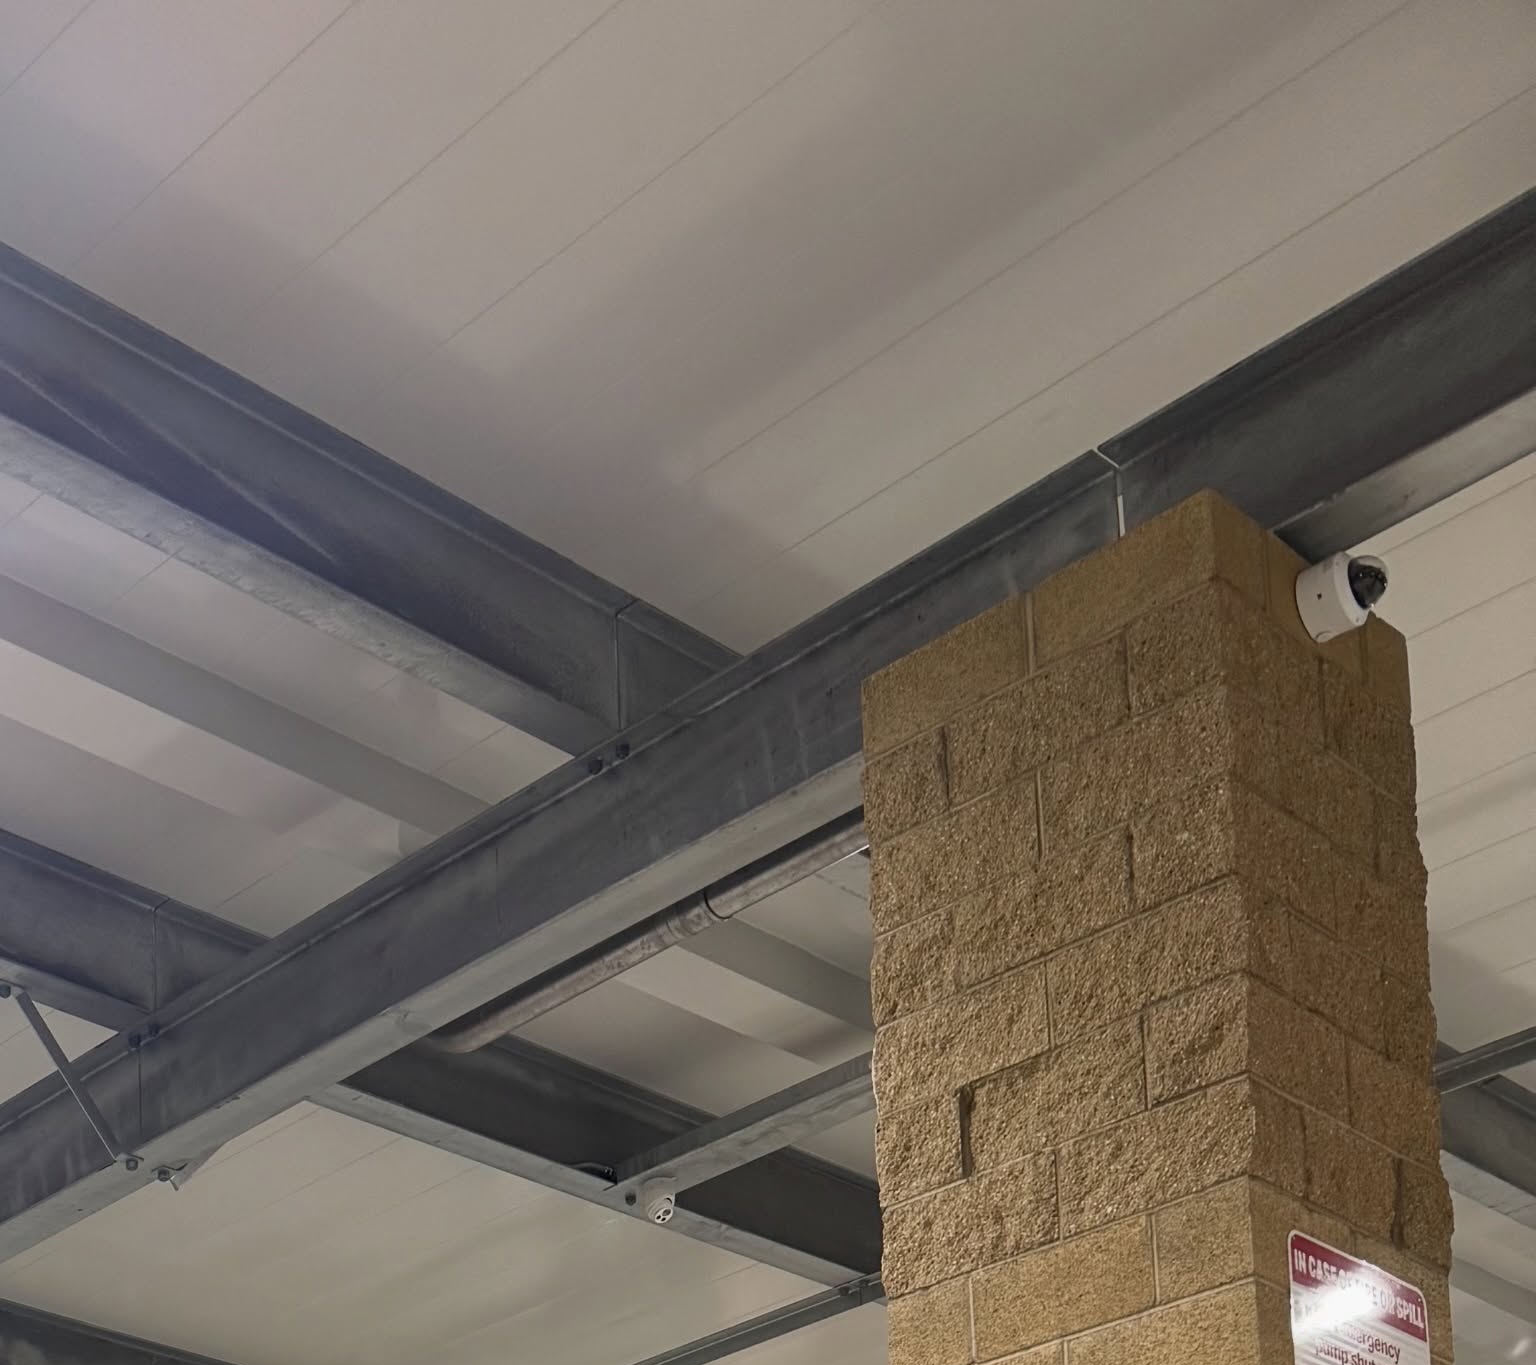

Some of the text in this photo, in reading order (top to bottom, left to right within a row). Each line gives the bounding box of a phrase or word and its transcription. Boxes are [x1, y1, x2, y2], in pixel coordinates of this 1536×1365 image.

[1294, 1248, 1307, 1274] IN
[1307, 1255, 1337, 1284] CASE
[1395, 1297, 1424, 1329] SPILL
